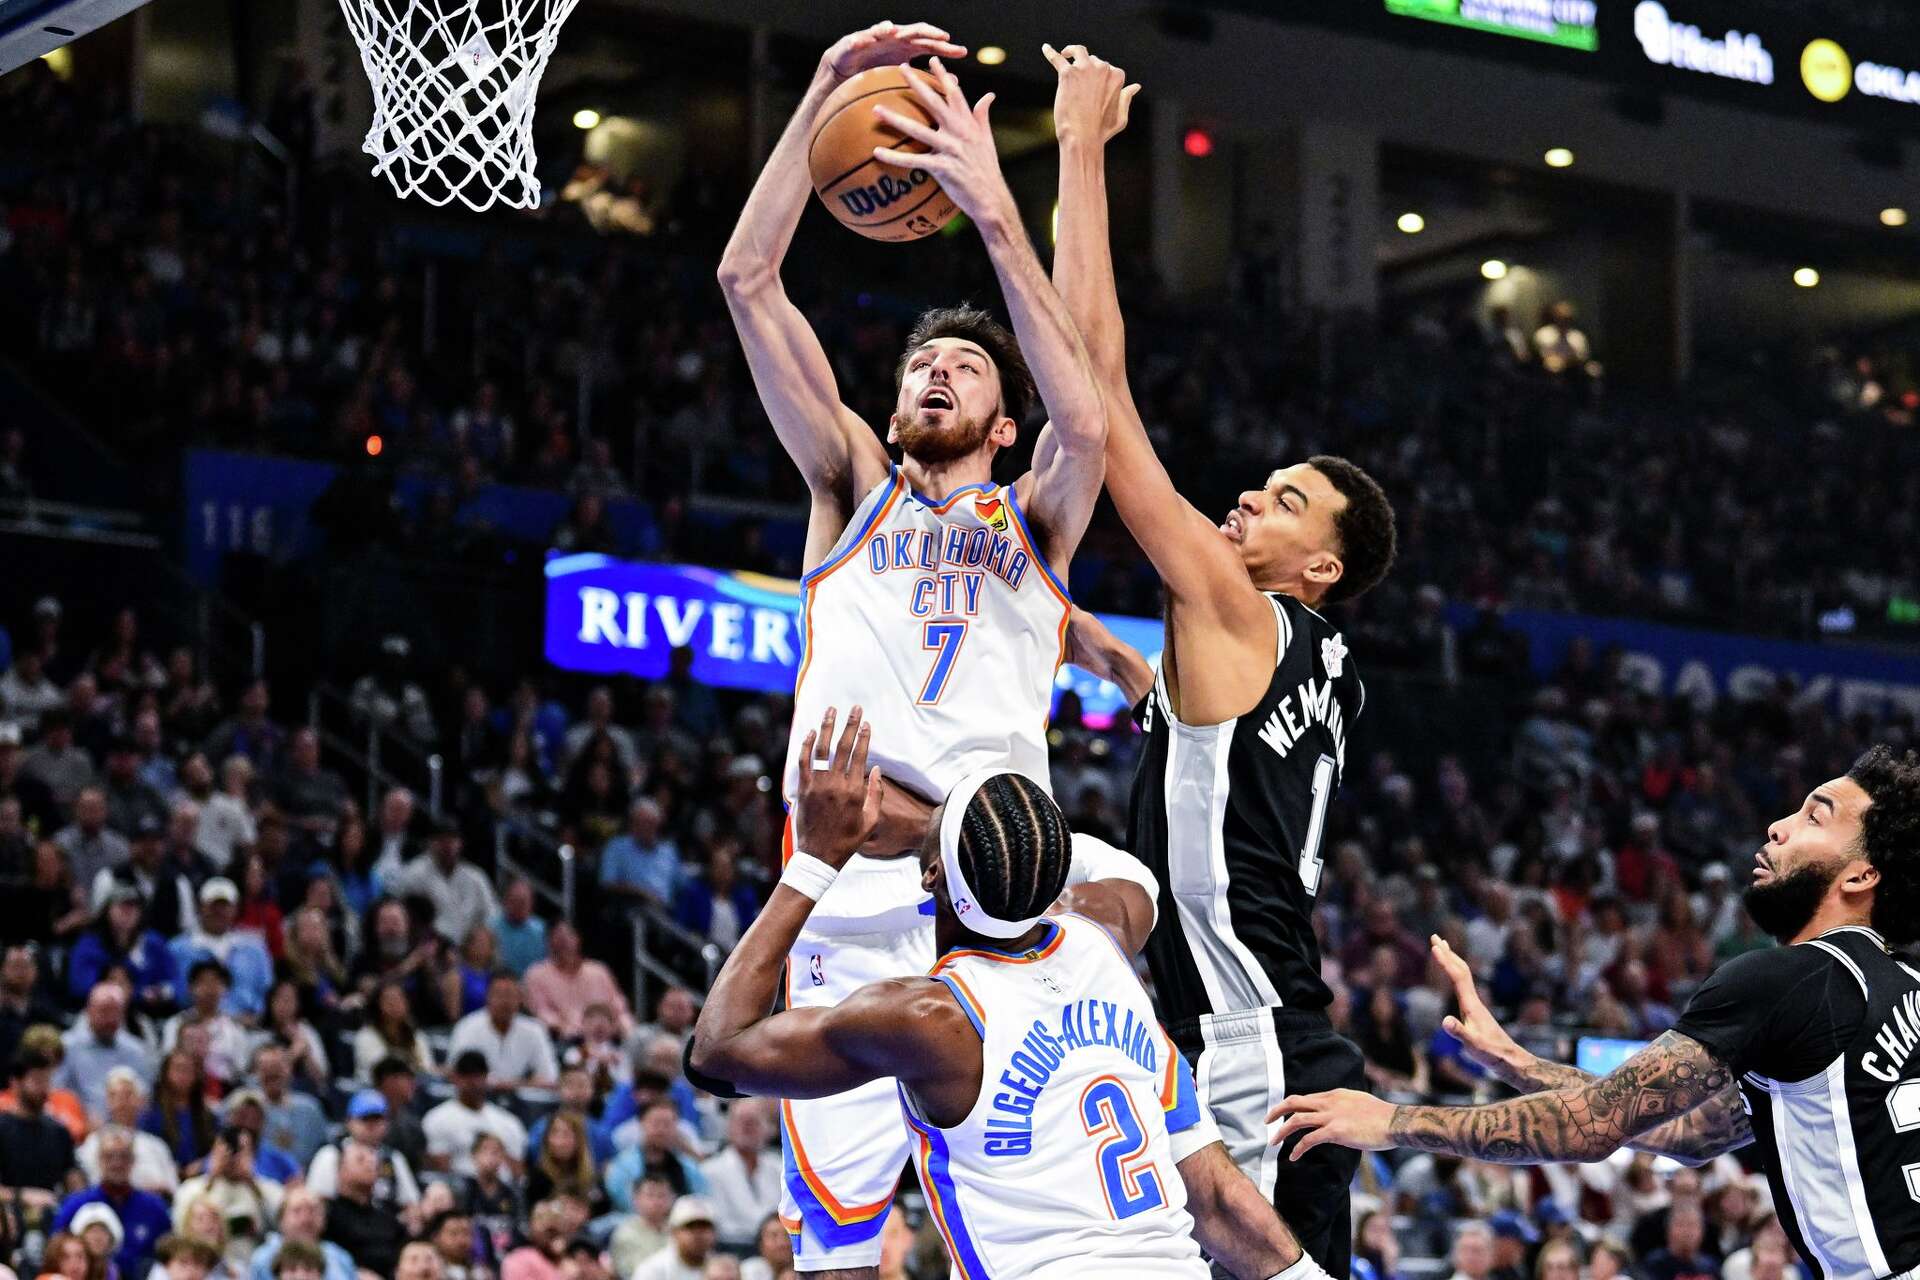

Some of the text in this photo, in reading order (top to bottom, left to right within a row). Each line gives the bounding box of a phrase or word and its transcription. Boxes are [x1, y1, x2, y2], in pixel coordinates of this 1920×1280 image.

[1669, 22, 1774, 86] Health
[868, 523, 1031, 593] OKLHOMA
[910, 570, 985, 618] CTY
[578, 585, 796, 668] RIVER
[916, 619, 969, 706] 7
[1298, 752, 1336, 898] 1
[1079, 1073, 1169, 1221] 2
